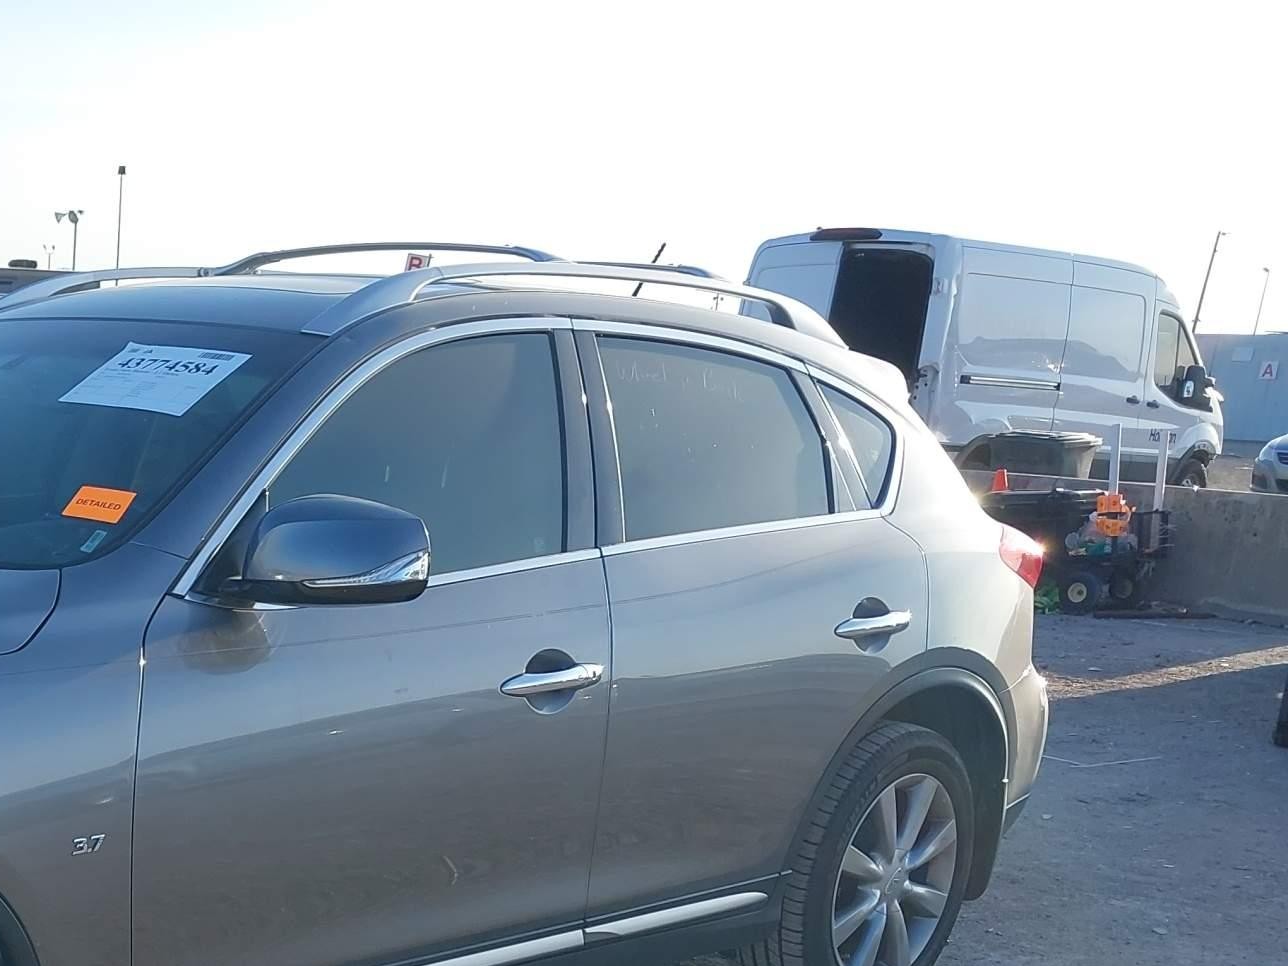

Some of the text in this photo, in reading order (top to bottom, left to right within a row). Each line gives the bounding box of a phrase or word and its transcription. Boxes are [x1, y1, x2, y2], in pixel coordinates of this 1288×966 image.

[118, 357, 219, 376] 43774584
[1262, 363, 1273, 377] A
[76, 498, 121, 511] DETAILED
[72, 834, 106, 855] 3.7
